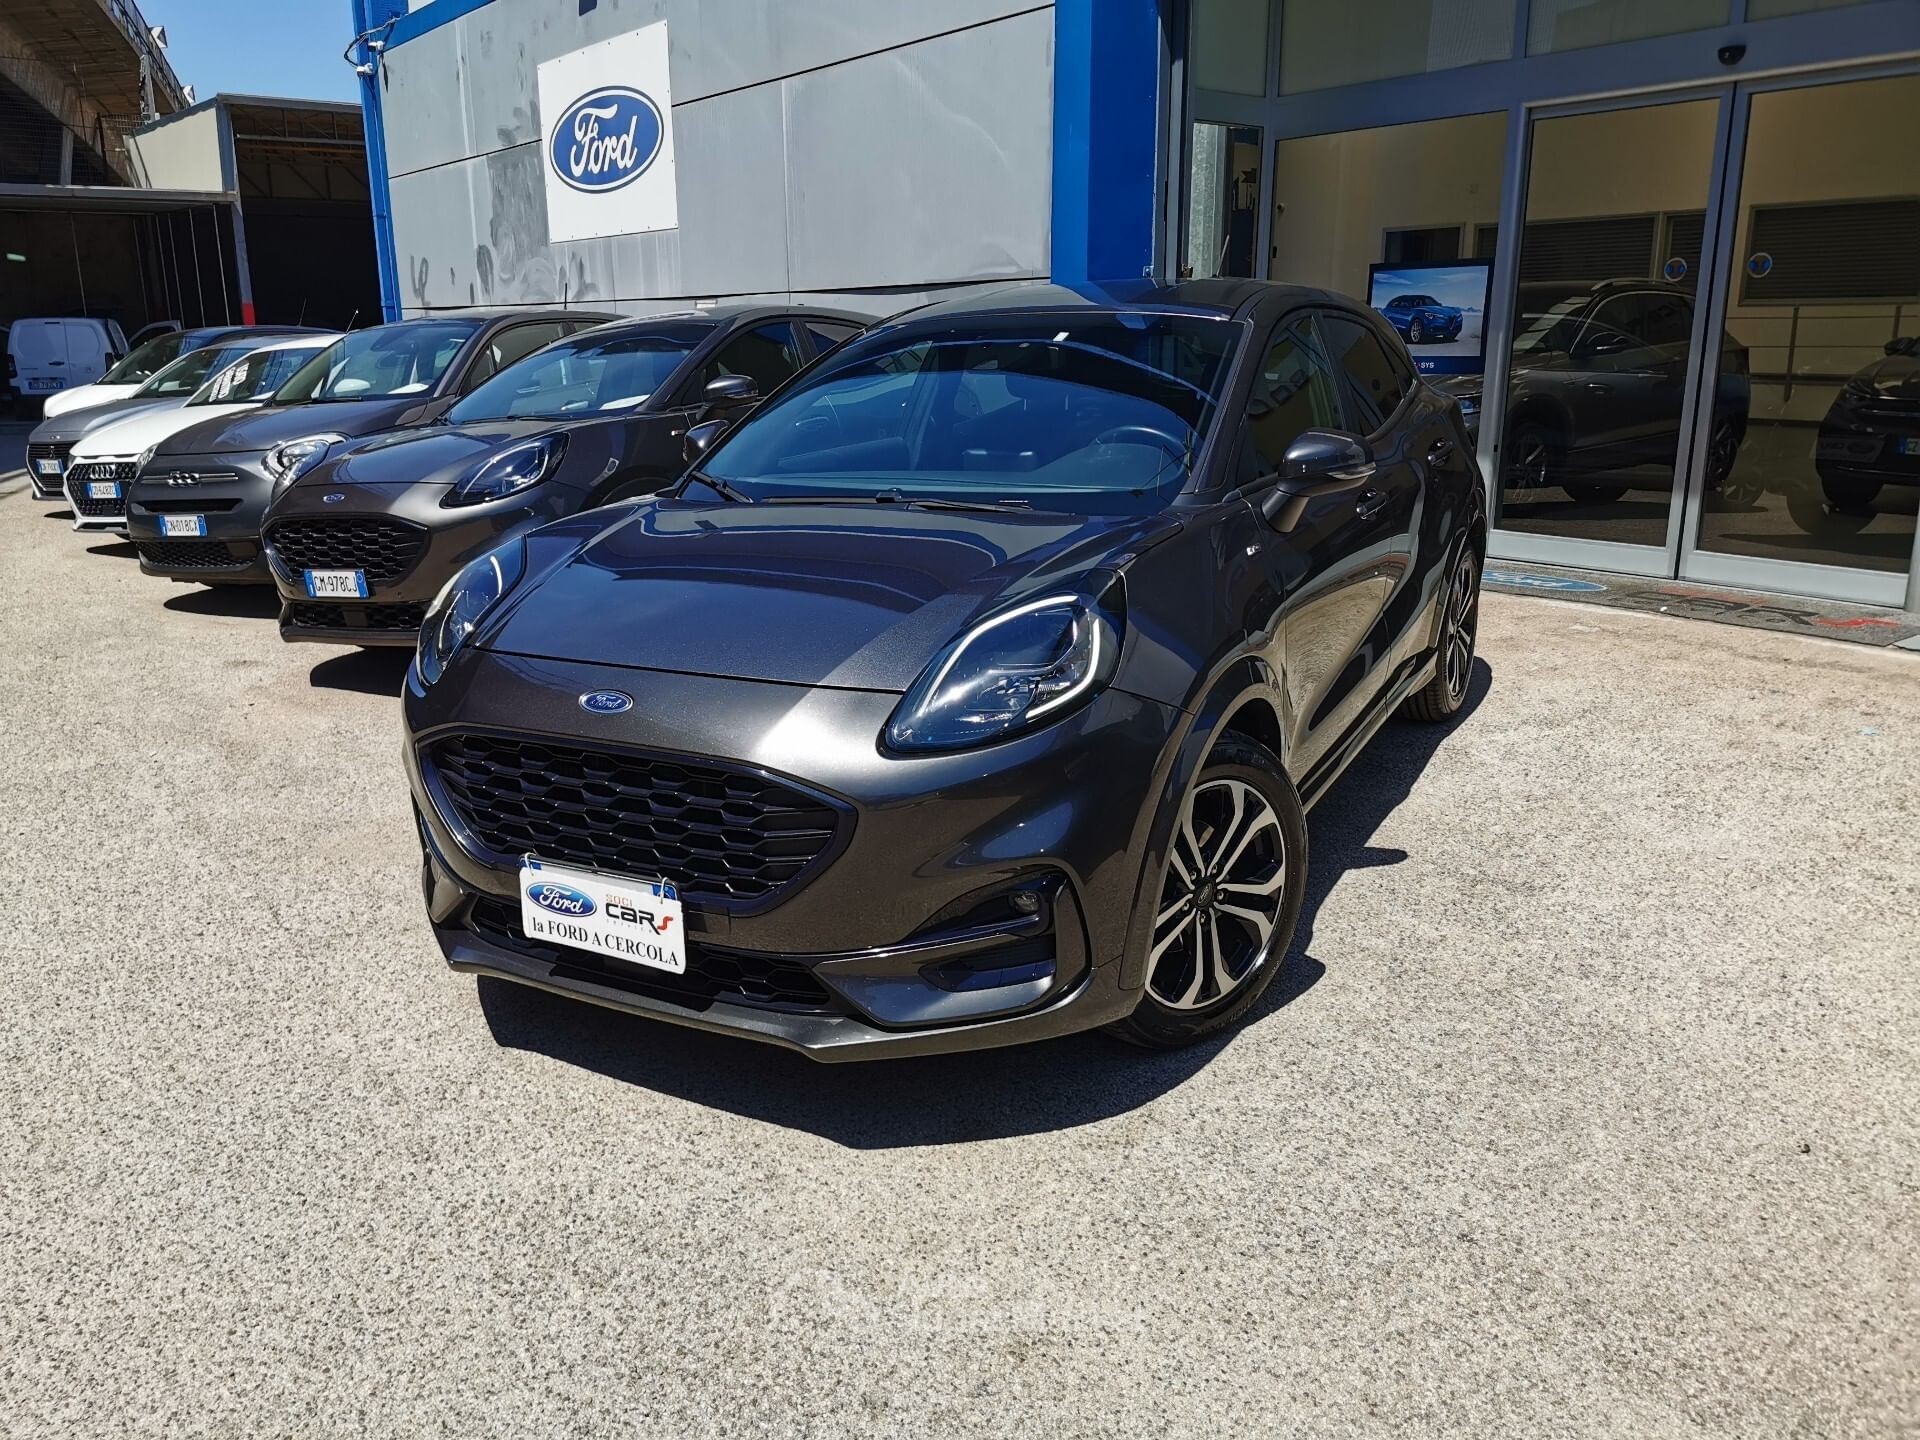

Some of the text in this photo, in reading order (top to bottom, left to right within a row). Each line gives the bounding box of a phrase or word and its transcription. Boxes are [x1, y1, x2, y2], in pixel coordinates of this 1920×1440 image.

[570, 103, 637, 177] Ford
[588, 693, 623, 709] Ford
[539, 885, 583, 913] Ford
[532, 916, 544, 932] la
[548, 920, 588, 943] FORD
[592, 932, 602, 947] A
[605, 933, 679, 966] CERCOLA
